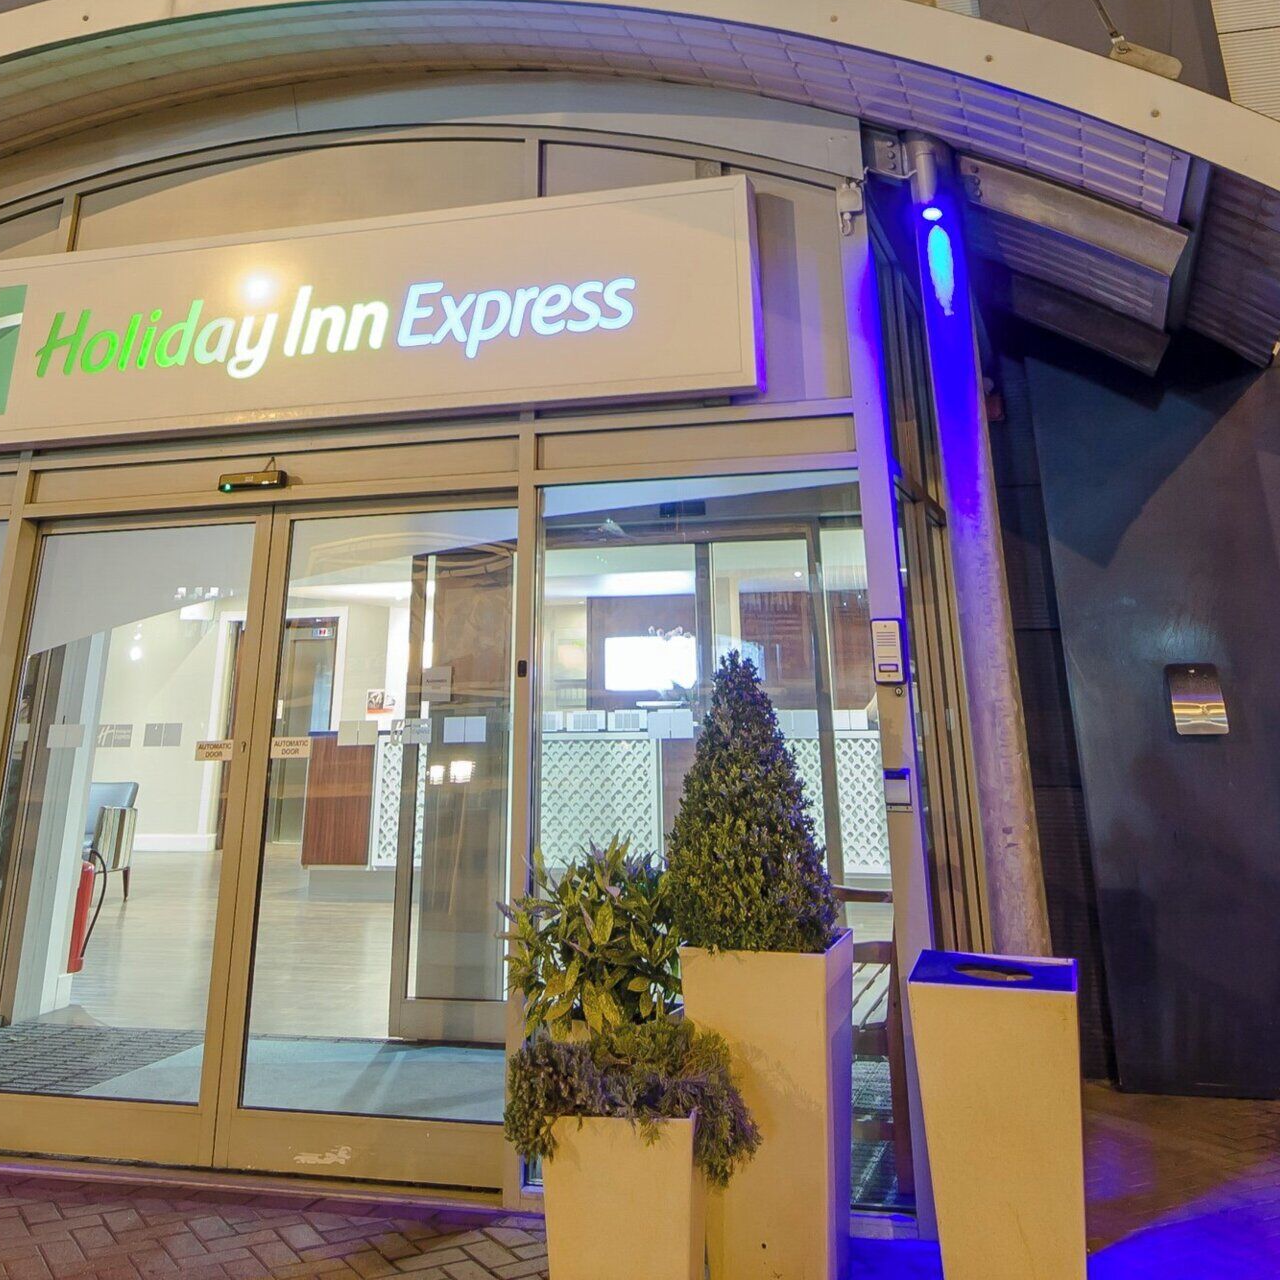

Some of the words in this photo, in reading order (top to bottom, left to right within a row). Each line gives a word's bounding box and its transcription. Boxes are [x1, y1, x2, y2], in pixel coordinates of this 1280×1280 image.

[35, 299, 279, 379] Holiday
[283, 284, 389, 357] Inn
[397, 277, 636, 359] Express
[198, 742, 231, 750] AUTOMATIC
[274, 739, 309, 747] AUTOMATIC
[205, 750, 223, 758] DOOR
